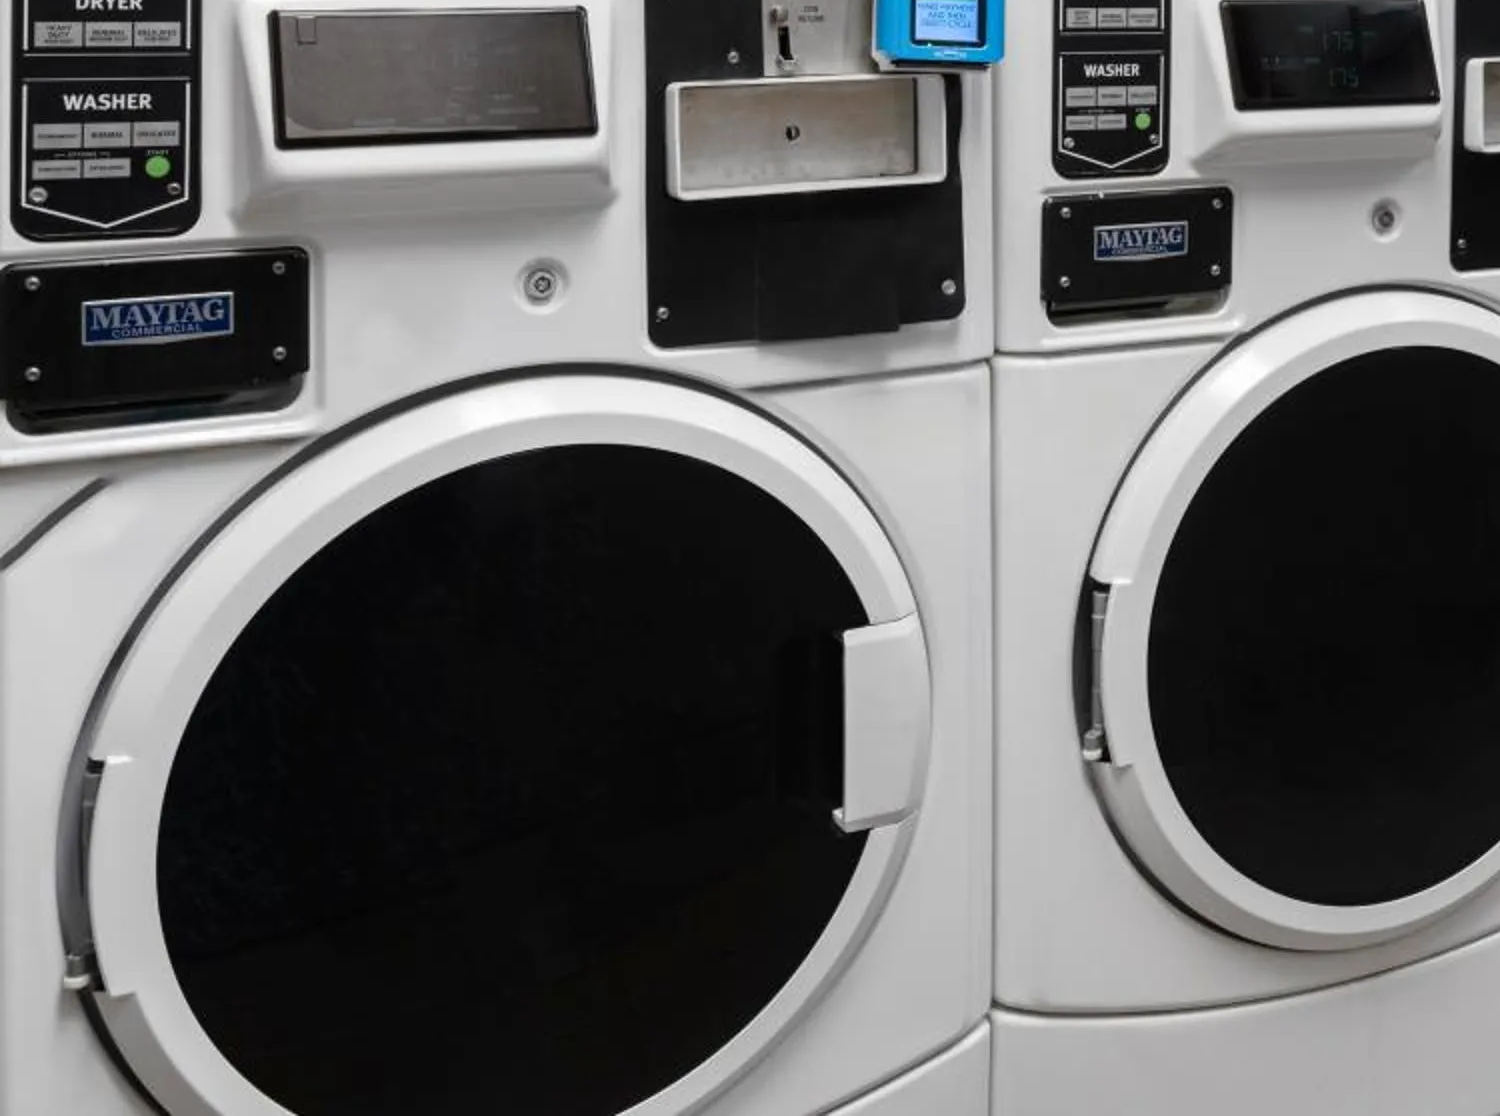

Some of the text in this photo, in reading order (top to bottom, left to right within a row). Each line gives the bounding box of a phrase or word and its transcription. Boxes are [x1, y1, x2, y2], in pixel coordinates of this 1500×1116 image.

[1084, 63, 1141, 78] WASHER
[63, 93, 152, 111] WASHER
[1100, 226, 1183, 249] MAYTAG
[90, 298, 224, 331] MAYTAG
[111, 323, 202, 339] COMMERCIAL
